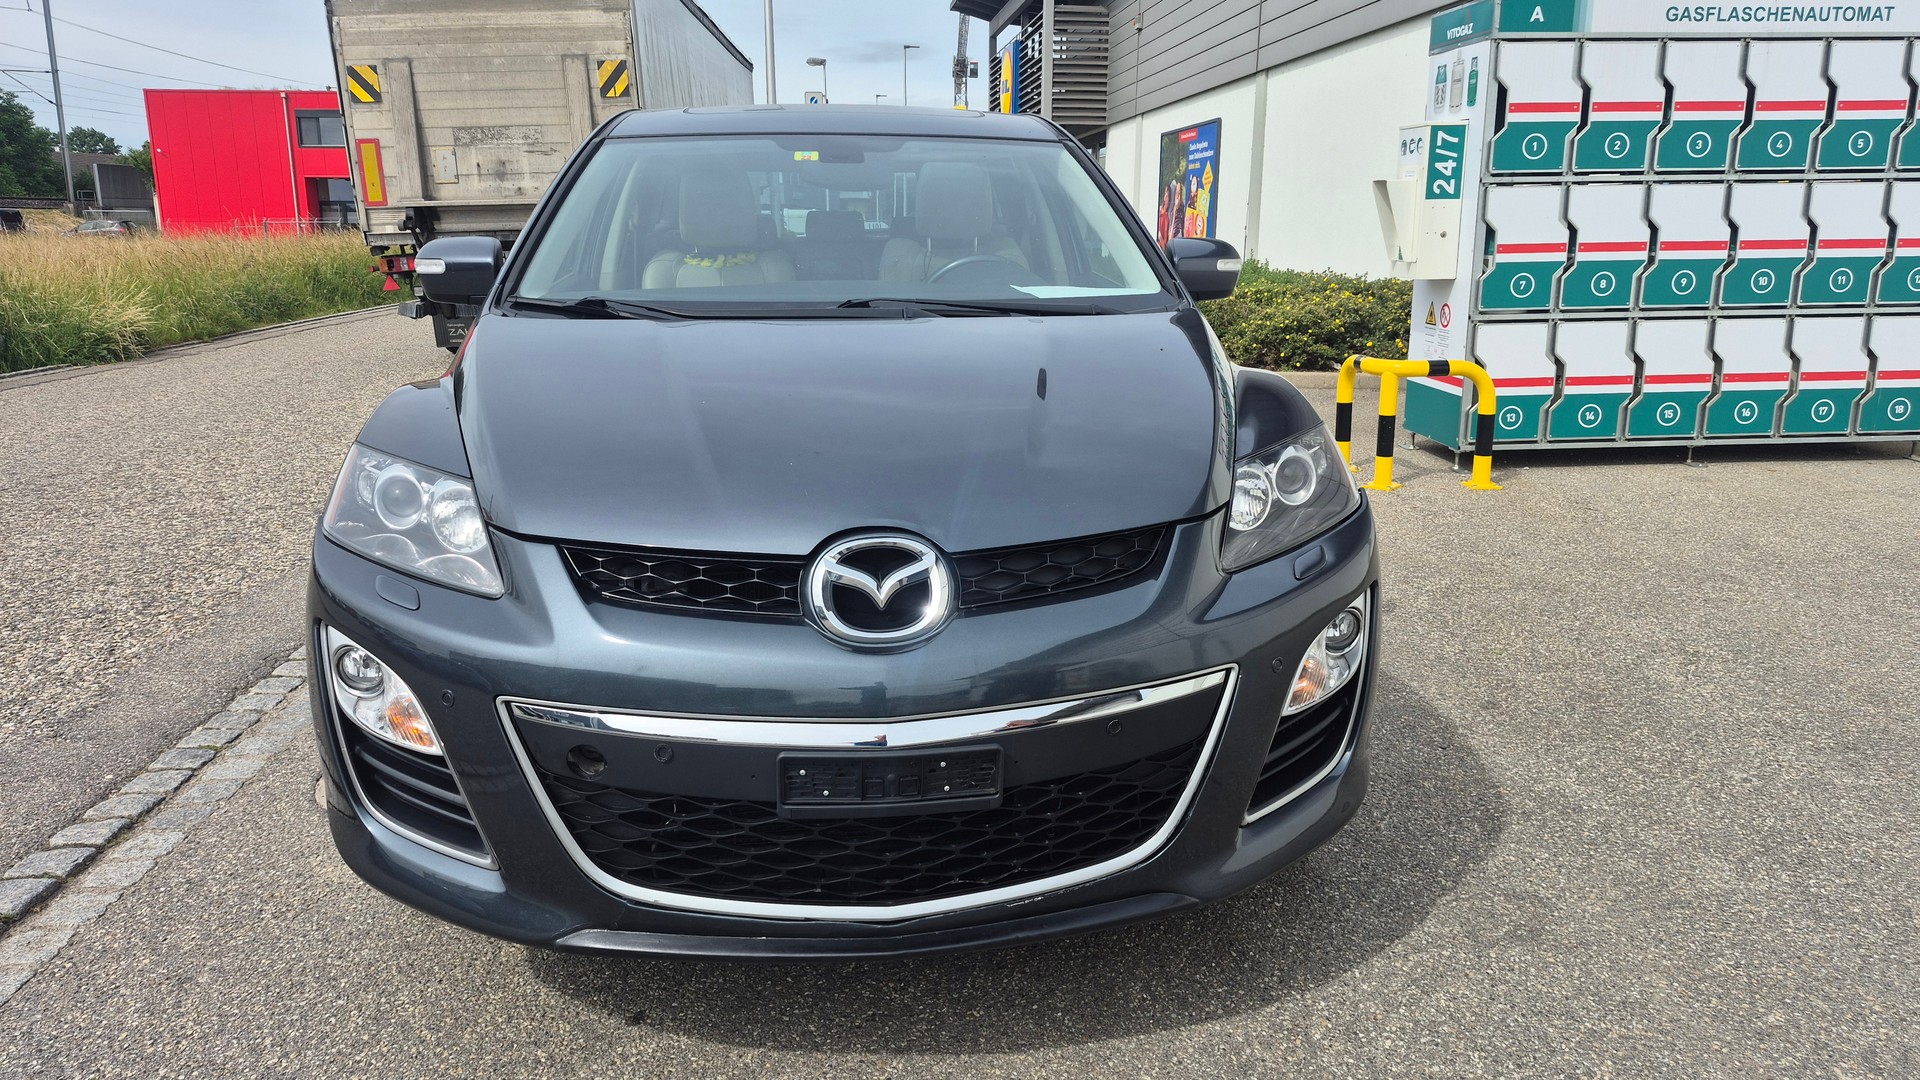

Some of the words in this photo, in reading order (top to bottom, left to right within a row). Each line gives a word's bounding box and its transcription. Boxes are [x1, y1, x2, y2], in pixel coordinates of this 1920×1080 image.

[1530, 6, 1544, 22] A
[1665, 6, 1895, 22] GASFLASCHENAUTOMAT
[1446, 23, 1474, 40] VITOGAZ
[1433, 130, 1459, 194] 24/7
[1600, 280, 1606, 288] 8
[1680, 278, 1688, 286] 9
[1759, 277, 1768, 285] 10
[1838, 276, 1845, 284] 11
[1520, 281, 1526, 289] 7
[1742, 408, 1750, 416] 16
[1819, 407, 1828, 415] 17
[1895, 405, 1904, 413] 18
[1507, 414, 1515, 422] 13
[1586, 412, 1594, 420] 14
[1664, 410, 1673, 418] 15
